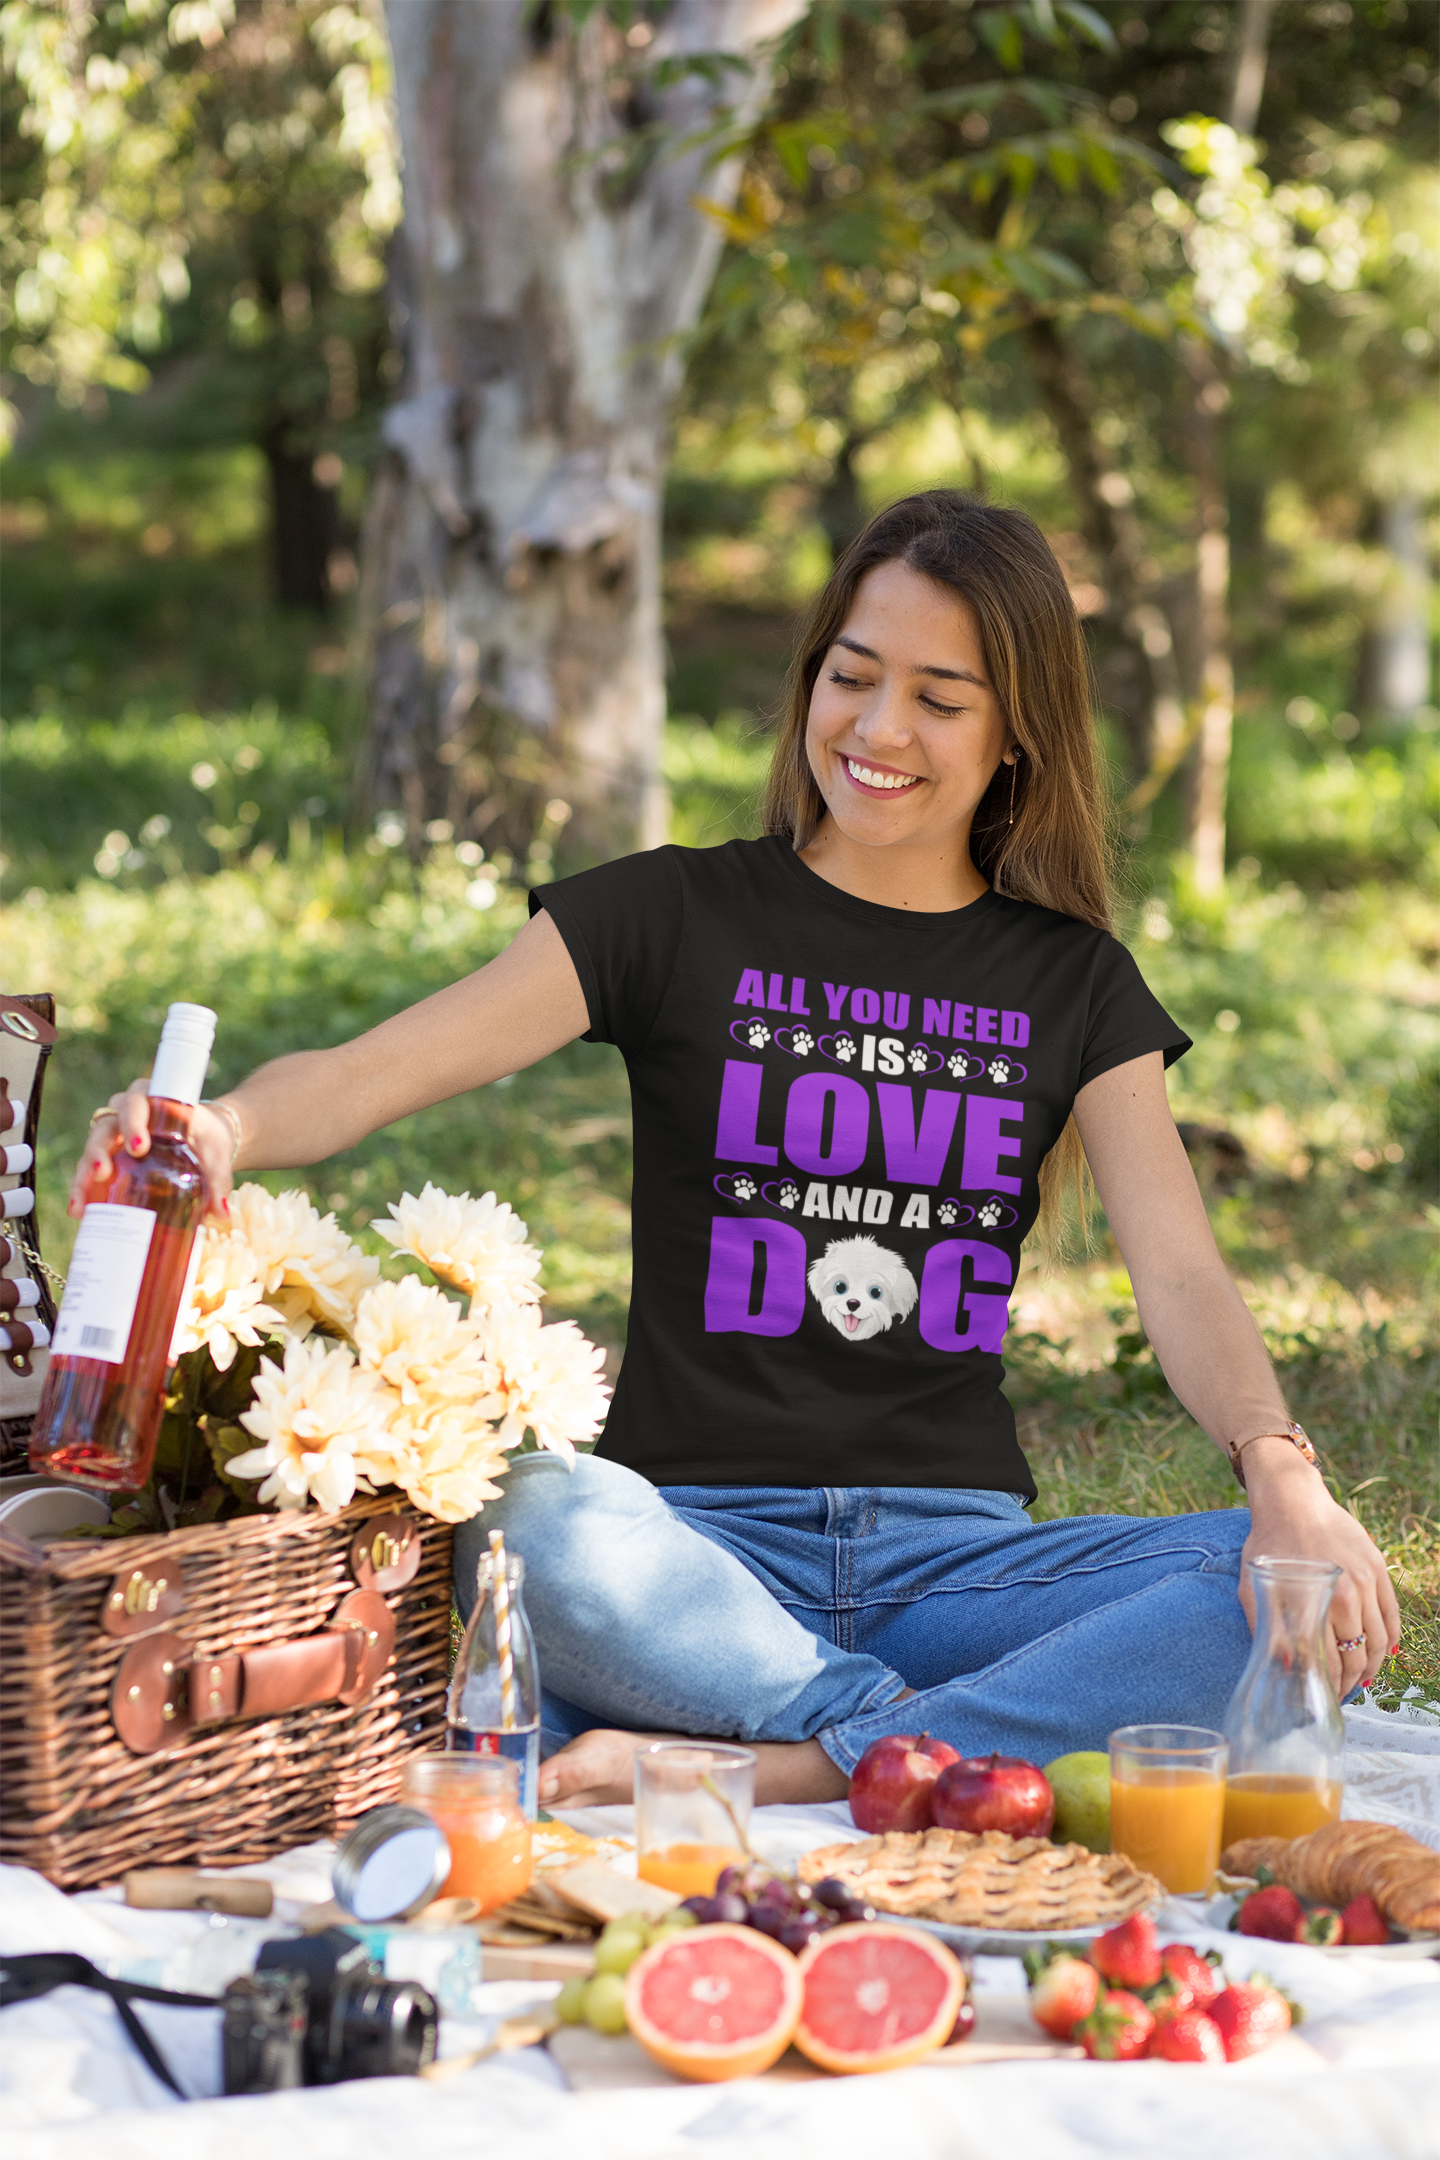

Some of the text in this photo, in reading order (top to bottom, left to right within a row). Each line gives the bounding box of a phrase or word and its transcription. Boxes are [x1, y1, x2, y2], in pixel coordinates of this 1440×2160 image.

[733, 968, 1030, 1048] ALL YOU NEED
[862, 1034, 905, 1075] IS
[714, 1058, 1024, 1197] LOVE
[802, 1182, 929, 1228] AND A
[704, 1216, 1012, 1354] DG
